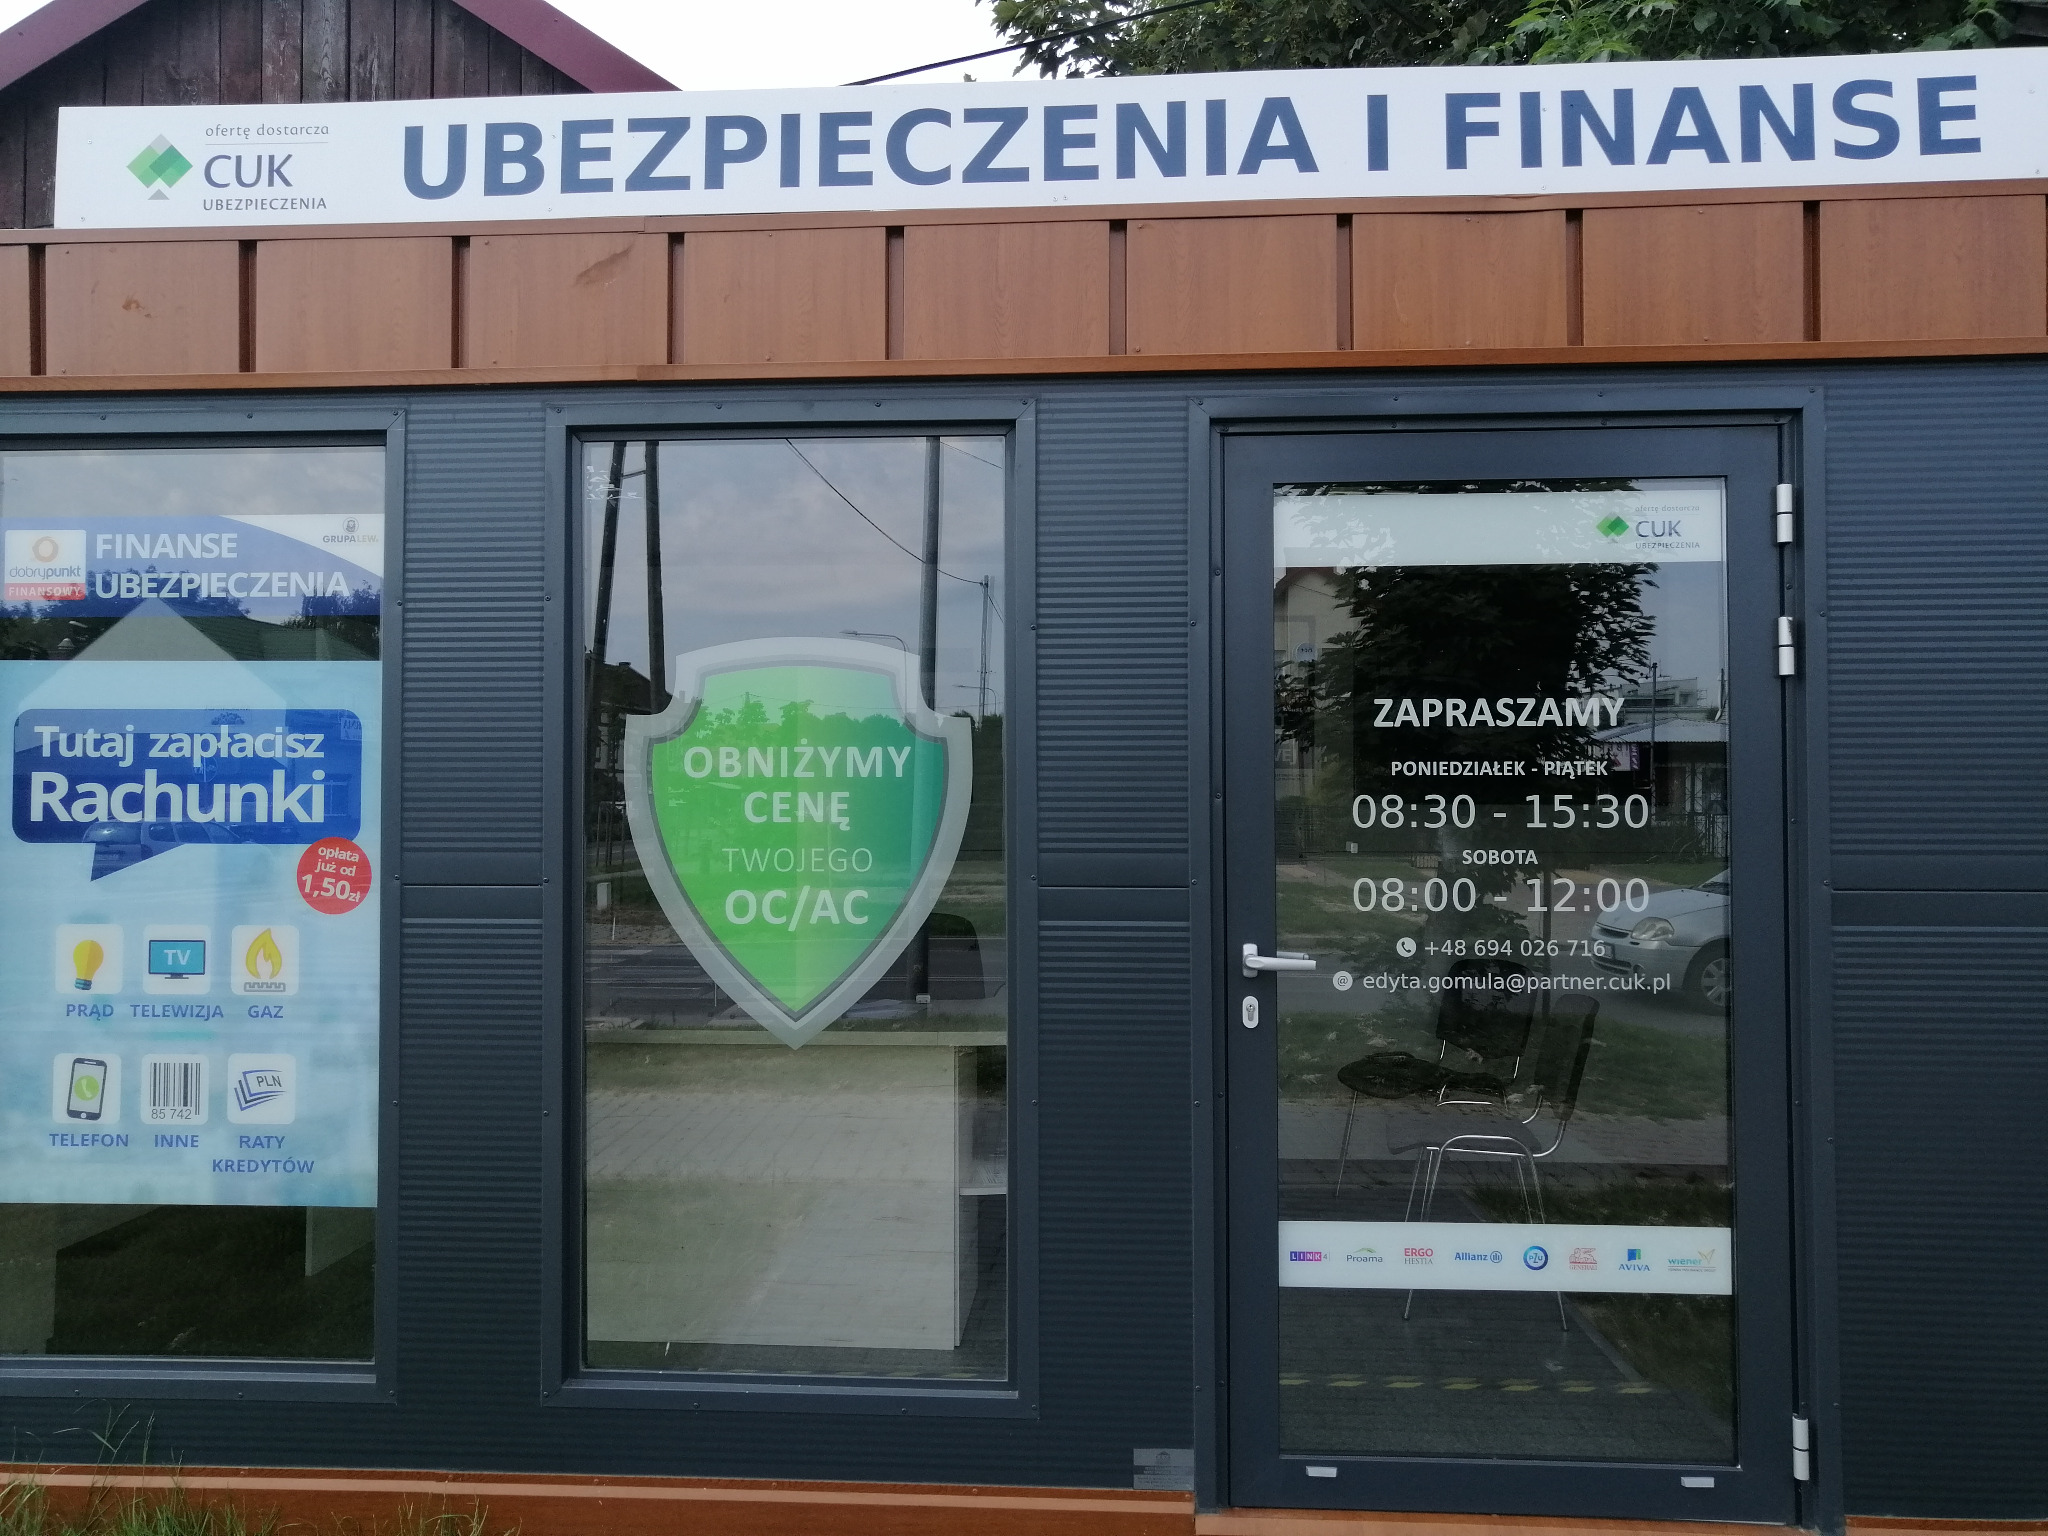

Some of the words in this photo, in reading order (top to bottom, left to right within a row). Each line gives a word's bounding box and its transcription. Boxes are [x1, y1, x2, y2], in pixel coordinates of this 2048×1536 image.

[205, 124, 250, 139] ofertę
[257, 123, 329, 136] dostarcza
[403, 97, 1320, 200] UBEZPIECZENIA
[1367, 94, 1389, 172] I
[1446, 75, 1982, 170] FINANSE
[203, 154, 294, 189] CUK
[203, 197, 327, 212] UBEZPIECZENIA
[1635, 520, 1682, 538] CUK
[96, 533, 238, 559] FINANSE
[1635, 541, 1700, 549] UBEZPIECZENIA
[8, 586, 81, 597] FINANSOWY
[95, 571, 350, 599] UBEZPIECZENIA
[1373, 697, 1625, 728] ZAPRASZAMY
[34, 725, 135, 767] Tutaj
[149, 725, 325, 767] zapłacisz
[683, 738, 911, 778] OBNIŻYMY
[1391, 761, 1526, 776] PONIEDZIAŁEK
[1544, 761, 1608, 780] PIĄTEK
[30, 769, 325, 823] Rachunki
[744, 791, 850, 831] CENĘ
[1352, 794, 1477, 829] 08:30
[1525, 794, 1649, 829] 15:30
[318, 847, 360, 862] opłata
[723, 847, 873, 872] TWOJEGO
[1462, 849, 1538, 865] SOBOTA
[314, 859, 337, 873] już
[340, 865, 357, 877] od
[1352, 877, 1477, 912] 08:00
[1527, 877, 1649, 912] 12:00
[725, 886, 869, 932] OC/AC
[1424, 939, 1467, 957] +48
[1474, 939, 1513, 957] 694
[1520, 939, 1559, 957] 026
[1569, 939, 1606, 957] 716
[164, 949, 191, 966] TV
[1362, 972, 1671, 994] edyta.gomula@partner.cuk.pl
[66, 1004, 114, 1020] PRĄD
[130, 1004, 224, 1021] TELEWIZJA
[247, 1005, 284, 1019] GAZ
[256, 1075, 282, 1088] PLN
[151, 1108, 166, 1120] 85
[170, 1108, 192, 1120] 742
[49, 1133, 129, 1147] TELEFON
[154, 1134, 199, 1148] INNE
[239, 1135, 285, 1149] RATY
[212, 1157, 315, 1173] KREDYTÓW
[1346, 1254, 1383, 1263] Proama
[1404, 1248, 1434, 1256] ERGO
[1454, 1252, 1488, 1261] Allianz
[1404, 1257, 1434, 1265] HESTIA
[1618, 1263, 1651, 1272] AVIVA
